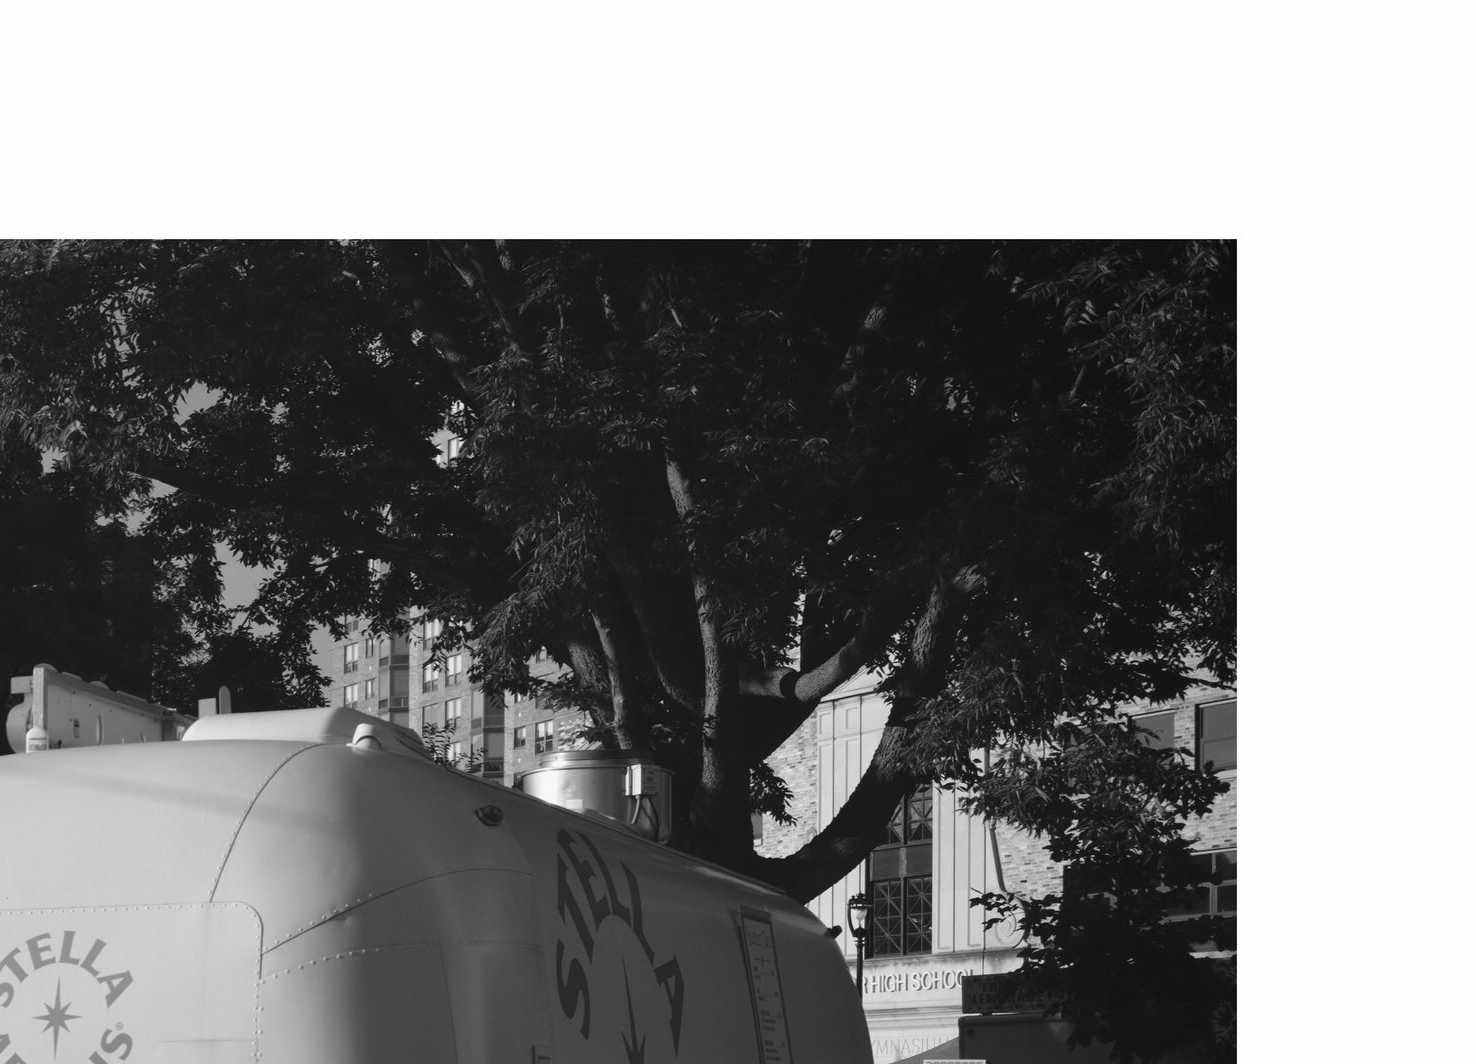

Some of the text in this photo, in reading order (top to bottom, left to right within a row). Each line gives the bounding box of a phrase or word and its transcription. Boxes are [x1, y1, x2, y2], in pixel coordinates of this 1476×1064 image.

[556, 828, 684, 1059] STELLA
[871, 972, 909, 994] HIGH
[912, 968, 974, 992] SCHOO
